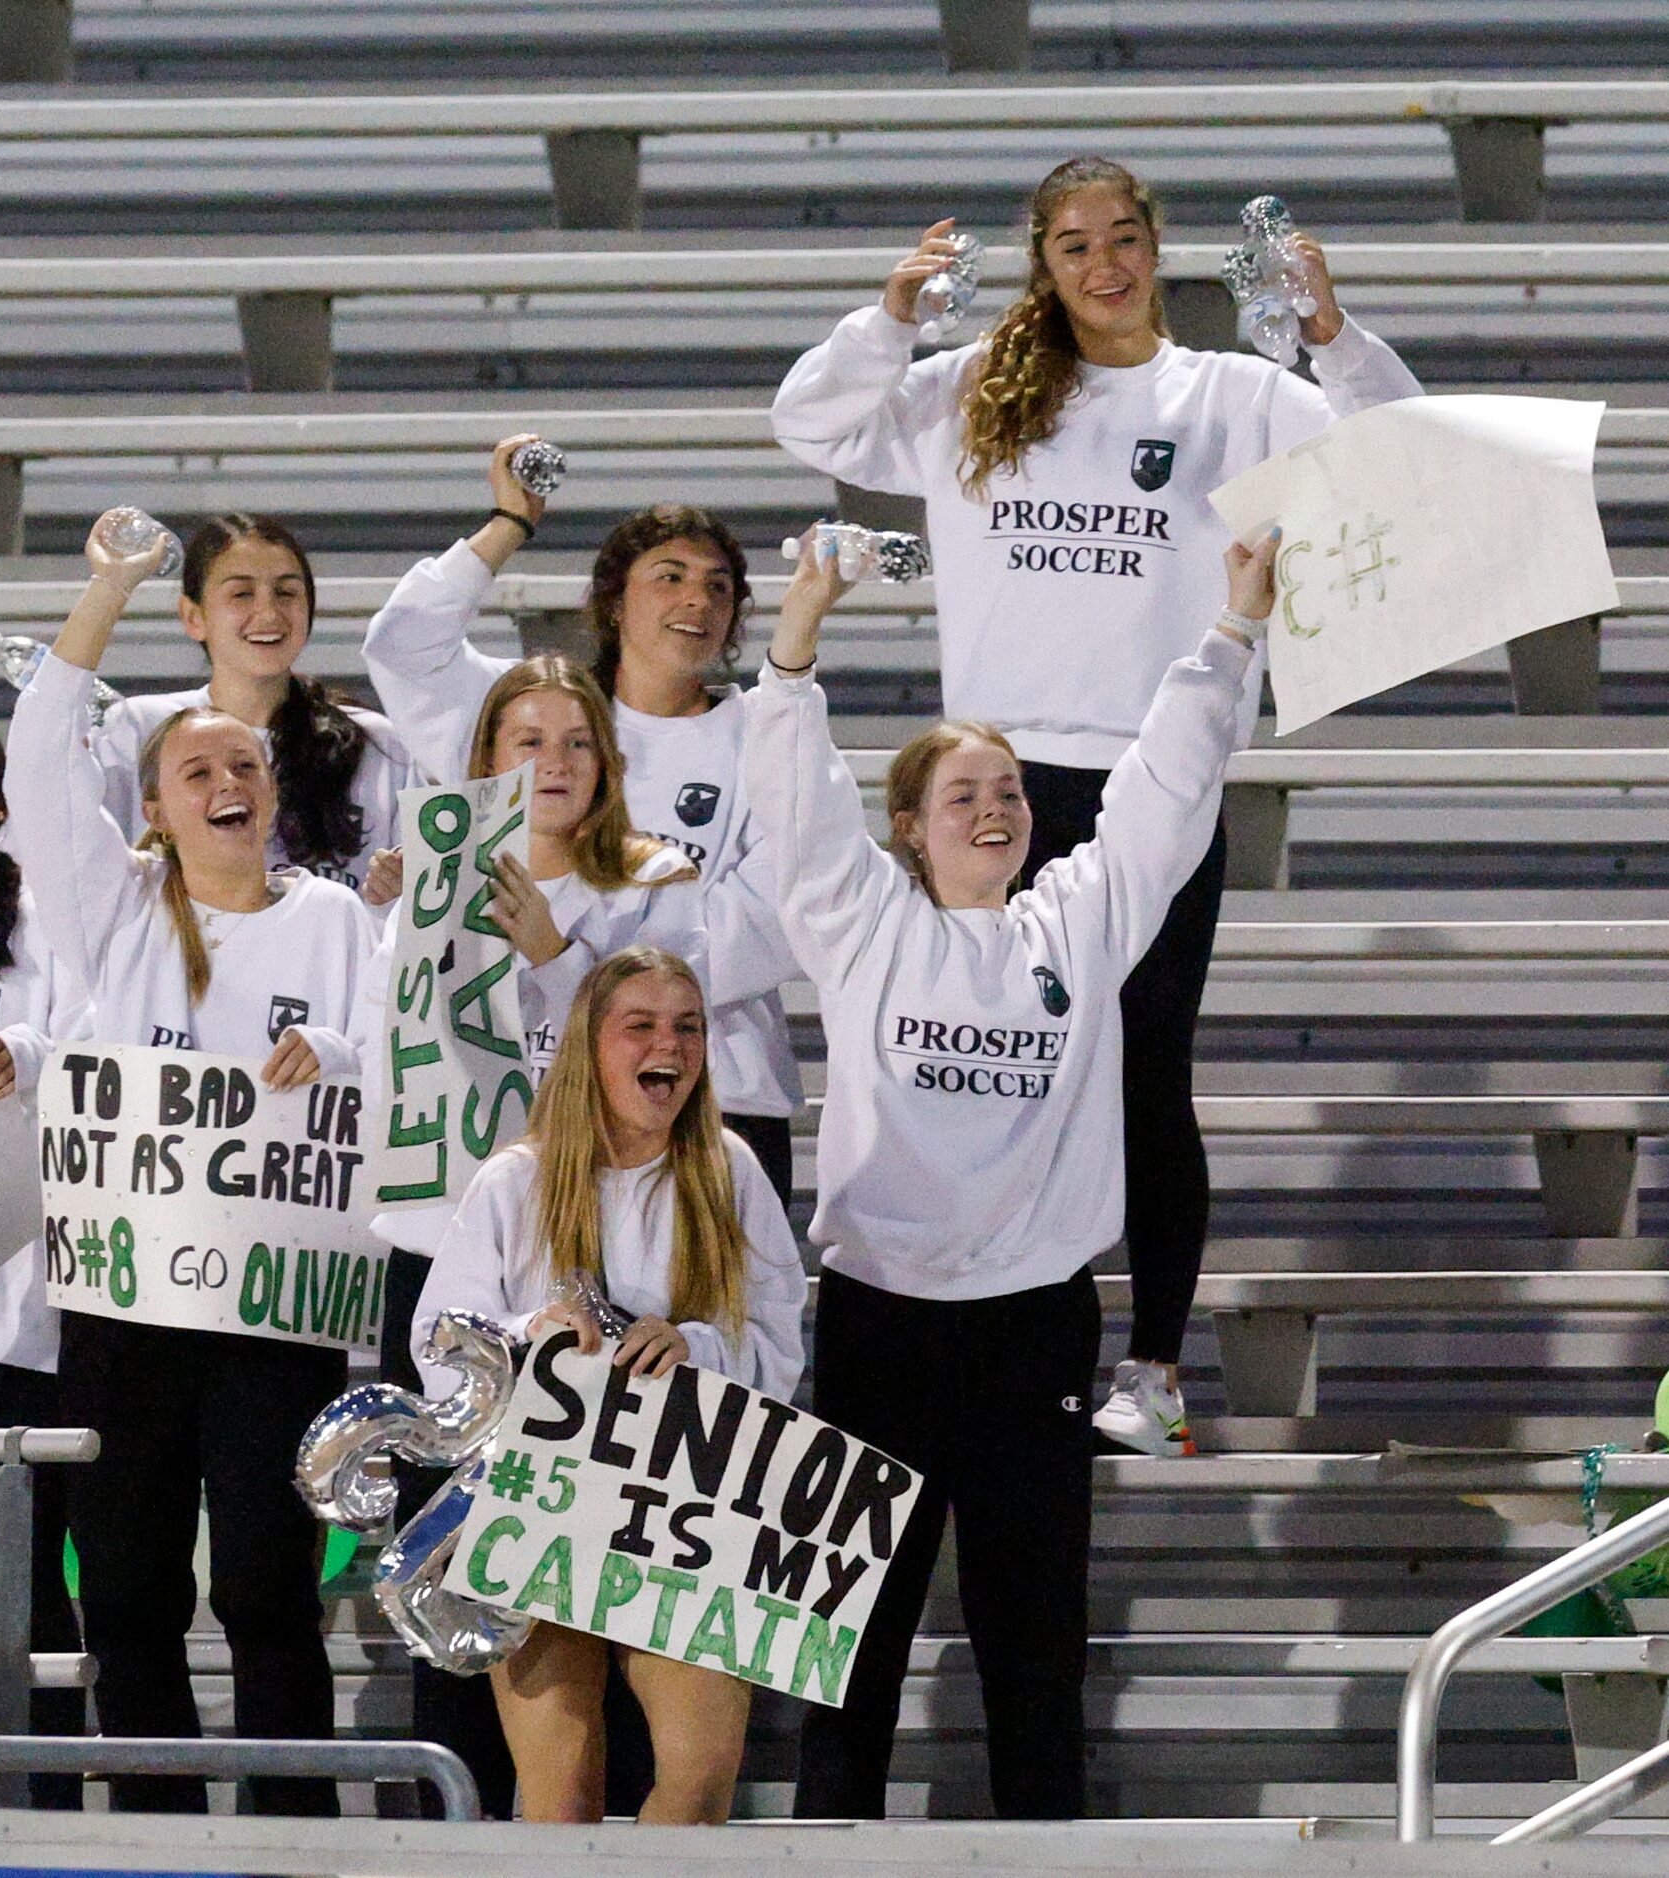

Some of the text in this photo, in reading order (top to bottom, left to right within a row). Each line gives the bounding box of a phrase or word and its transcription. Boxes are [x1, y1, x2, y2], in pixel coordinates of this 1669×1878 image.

[989, 499, 1171, 541] PROSPER
[1007, 543, 1145, 578] SOCCER
[413, 793, 471, 930] GO
[894, 1016, 1068, 1061] PROSPE
[63, 1054, 362, 1146] TO BAD UR
[42, 1127, 363, 1212] NOT AS GREAT
[170, 1245, 227, 1290] GO
[239, 1242, 384, 1346] OLIVIA!
[521, 1329, 912, 1560] SENIOR
[487, 1448, 870, 1620] #5 IS MY
[467, 1515, 857, 1705] CAPTAIN
